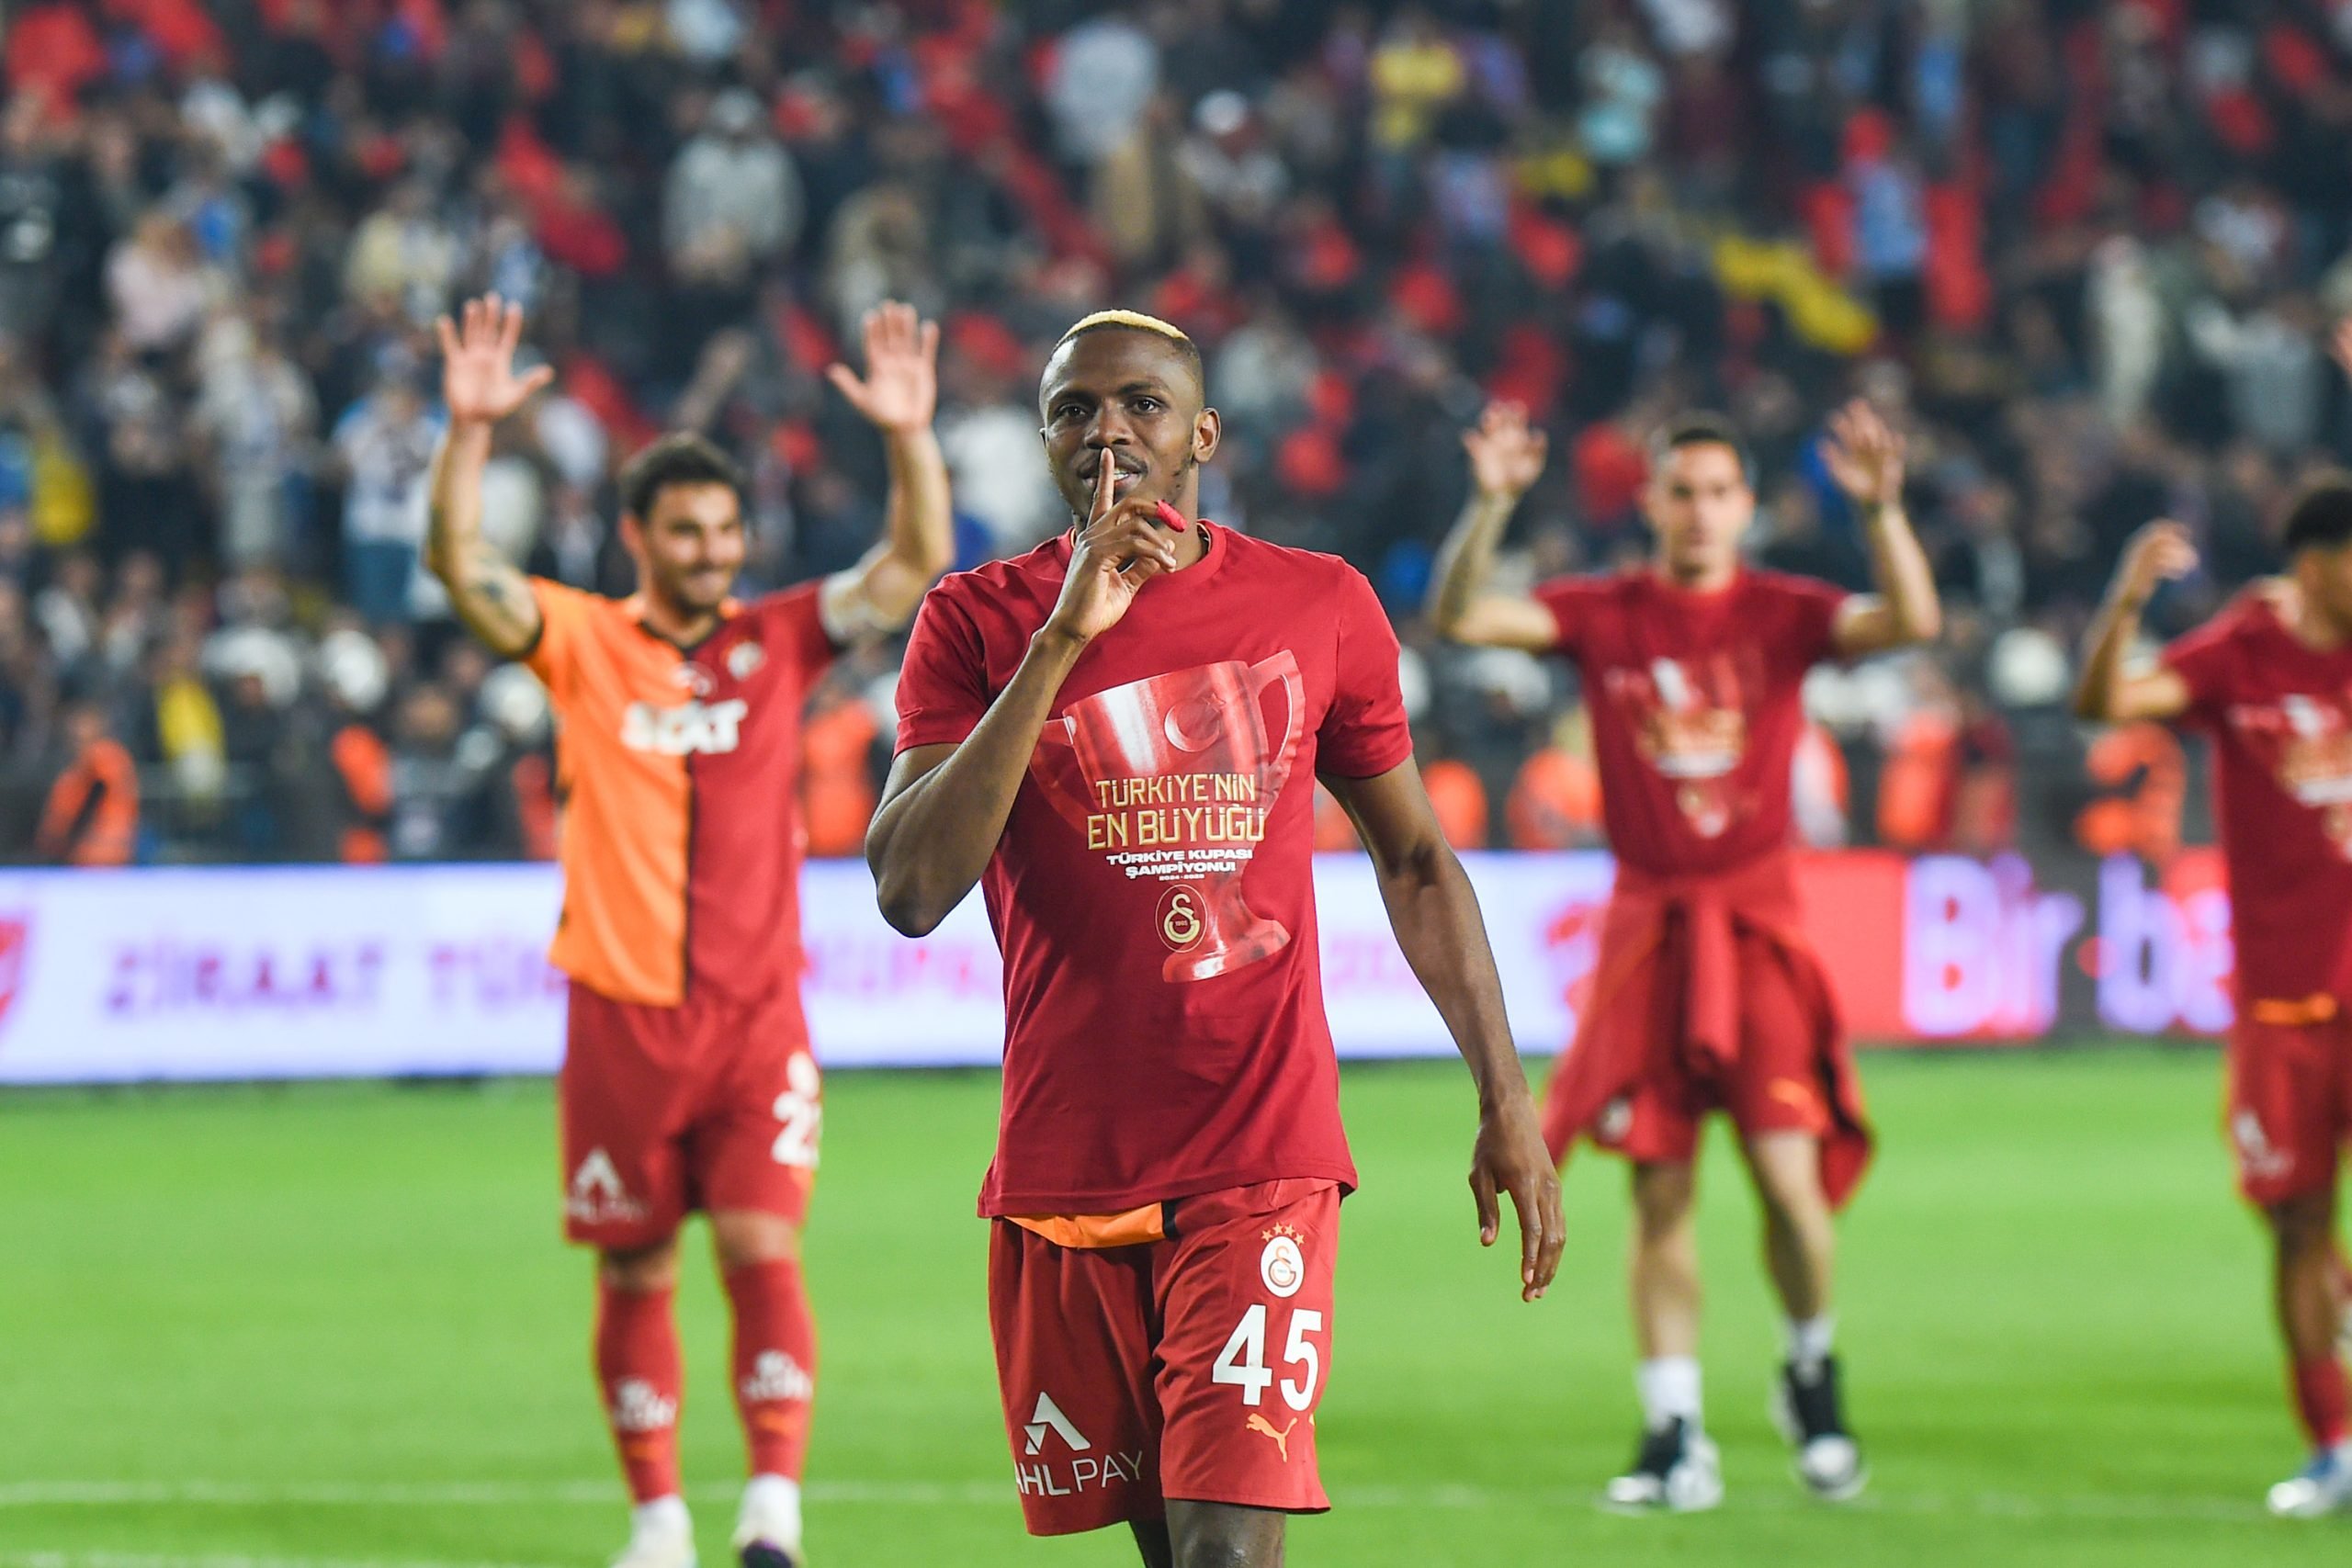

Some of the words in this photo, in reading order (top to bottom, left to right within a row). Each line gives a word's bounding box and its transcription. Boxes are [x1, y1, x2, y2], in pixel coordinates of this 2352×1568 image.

[1087, 812, 1128, 850] EN
[1137, 804, 1265, 846] BÜYÜĞÜ
[1106, 850, 1185, 865] TÜRKİYE
[1188, 849, 1253, 861] KUPASI
[1125, 862, 1236, 879] ŞAMPİYONU!
[1212, 1303, 1322, 1411] 45
[1072, 1450, 1142, 1492] PAY
